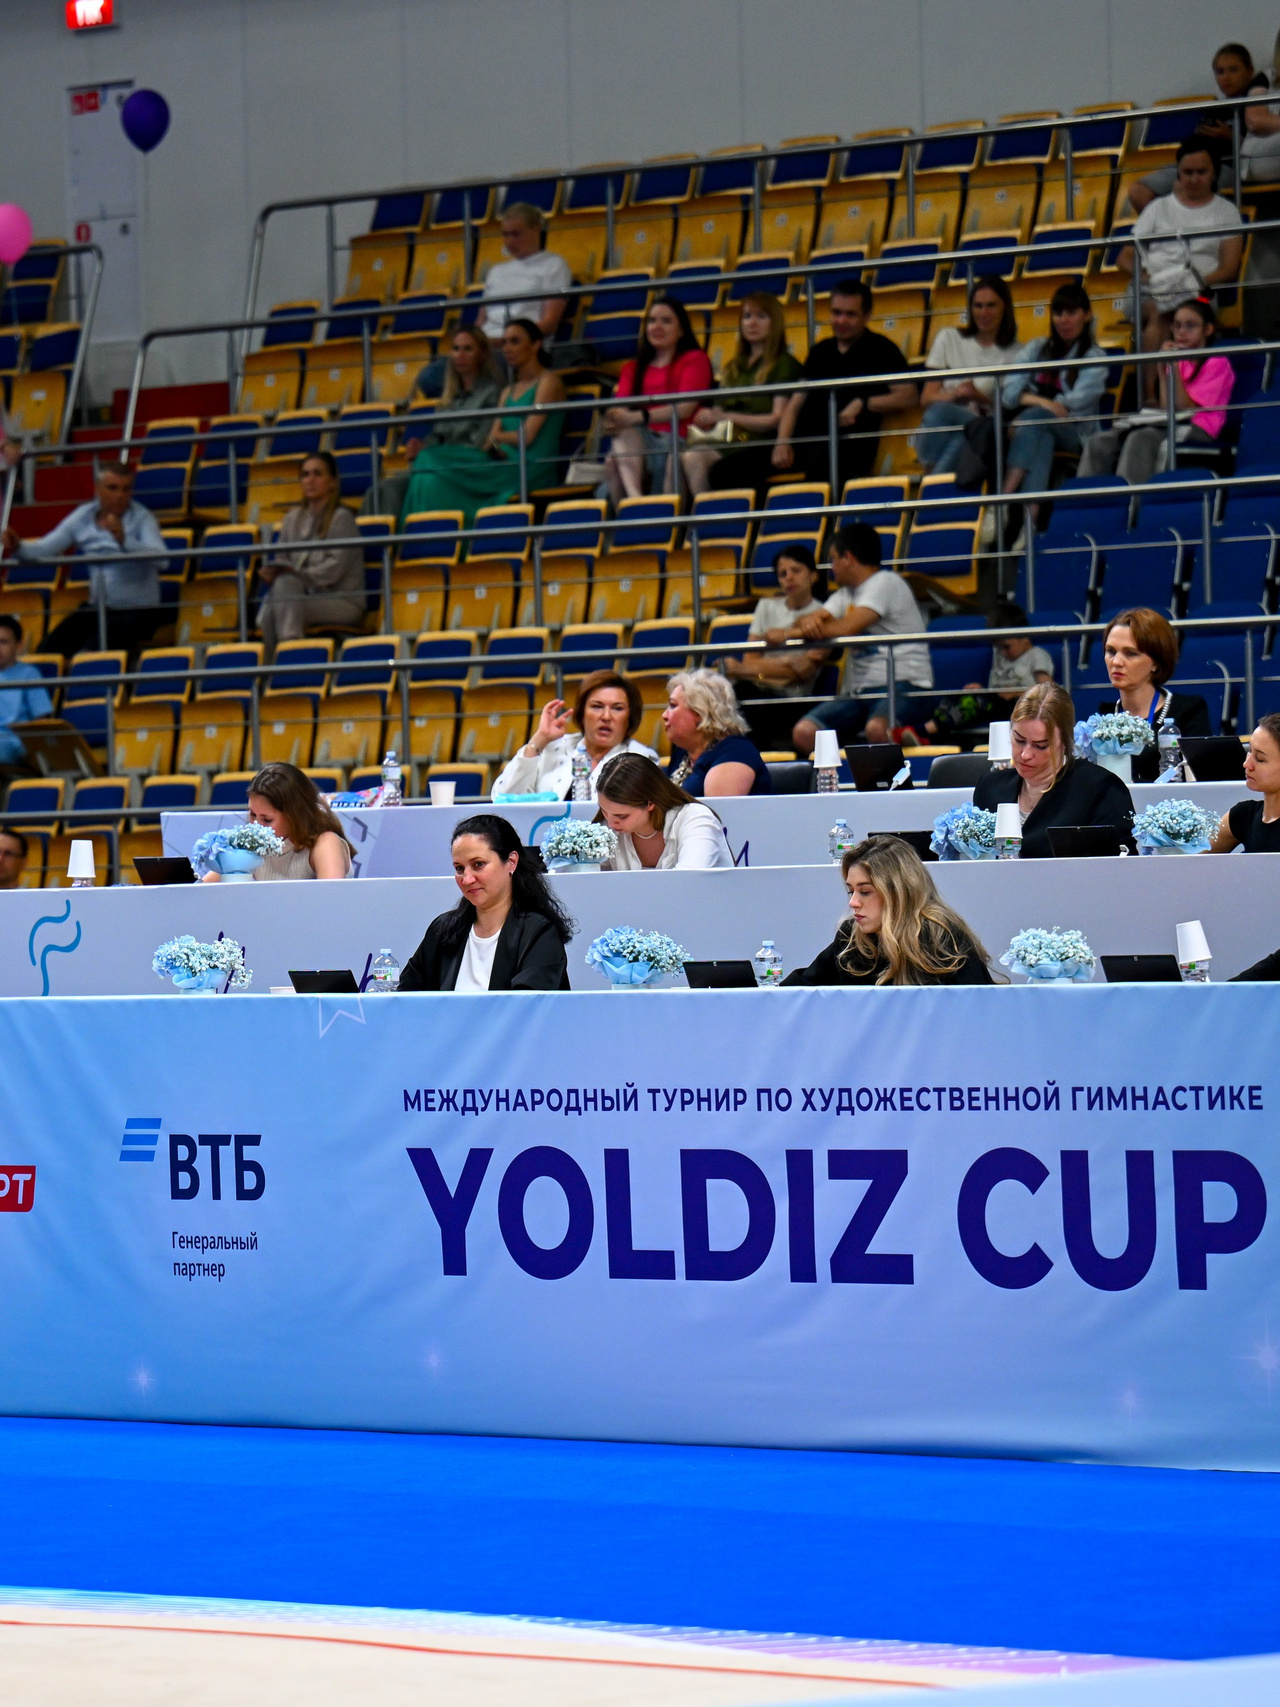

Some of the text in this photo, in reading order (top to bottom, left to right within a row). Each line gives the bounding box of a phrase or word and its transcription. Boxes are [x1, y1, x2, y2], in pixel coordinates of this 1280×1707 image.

[403, 1080, 1264, 1116] МЕЖДУНАРОДНЫЙ ТУРНИР ПО ХУДОЖЕСТВЕННОЙ ГИМНАСТИКЕ
[168, 1133, 266, 1201] ВТБ
[405, 1145, 1268, 1292] YOLDIZ CUP
[172, 1231, 258, 1254] Генеральный
[173, 1262, 226, 1282] партнер
